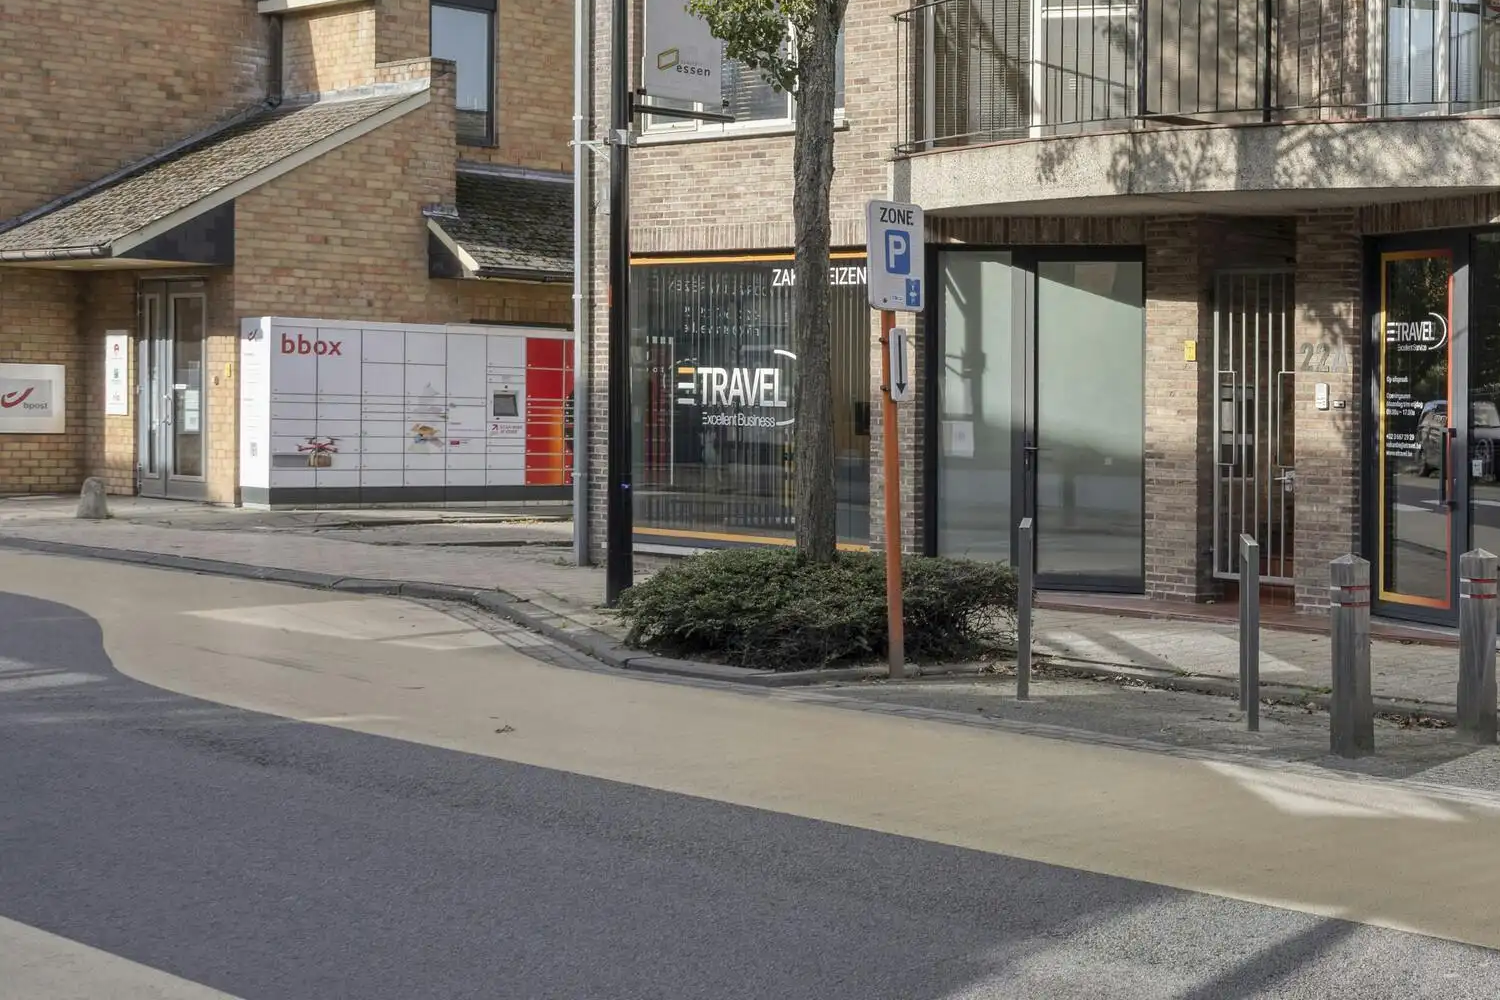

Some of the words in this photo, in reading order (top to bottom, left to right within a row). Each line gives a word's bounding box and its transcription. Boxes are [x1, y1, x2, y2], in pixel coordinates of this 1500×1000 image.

[676, 64, 711, 77] essen
[879, 206, 914, 226] ZONE
[888, 234, 907, 269] P
[281, 332, 342, 356] bbox
[1300, 341, 1348, 373] 22A
[23, 401, 48, 410] bpost
[702, 411, 737, 426] Excellent
[737, 412, 776, 428] Business
